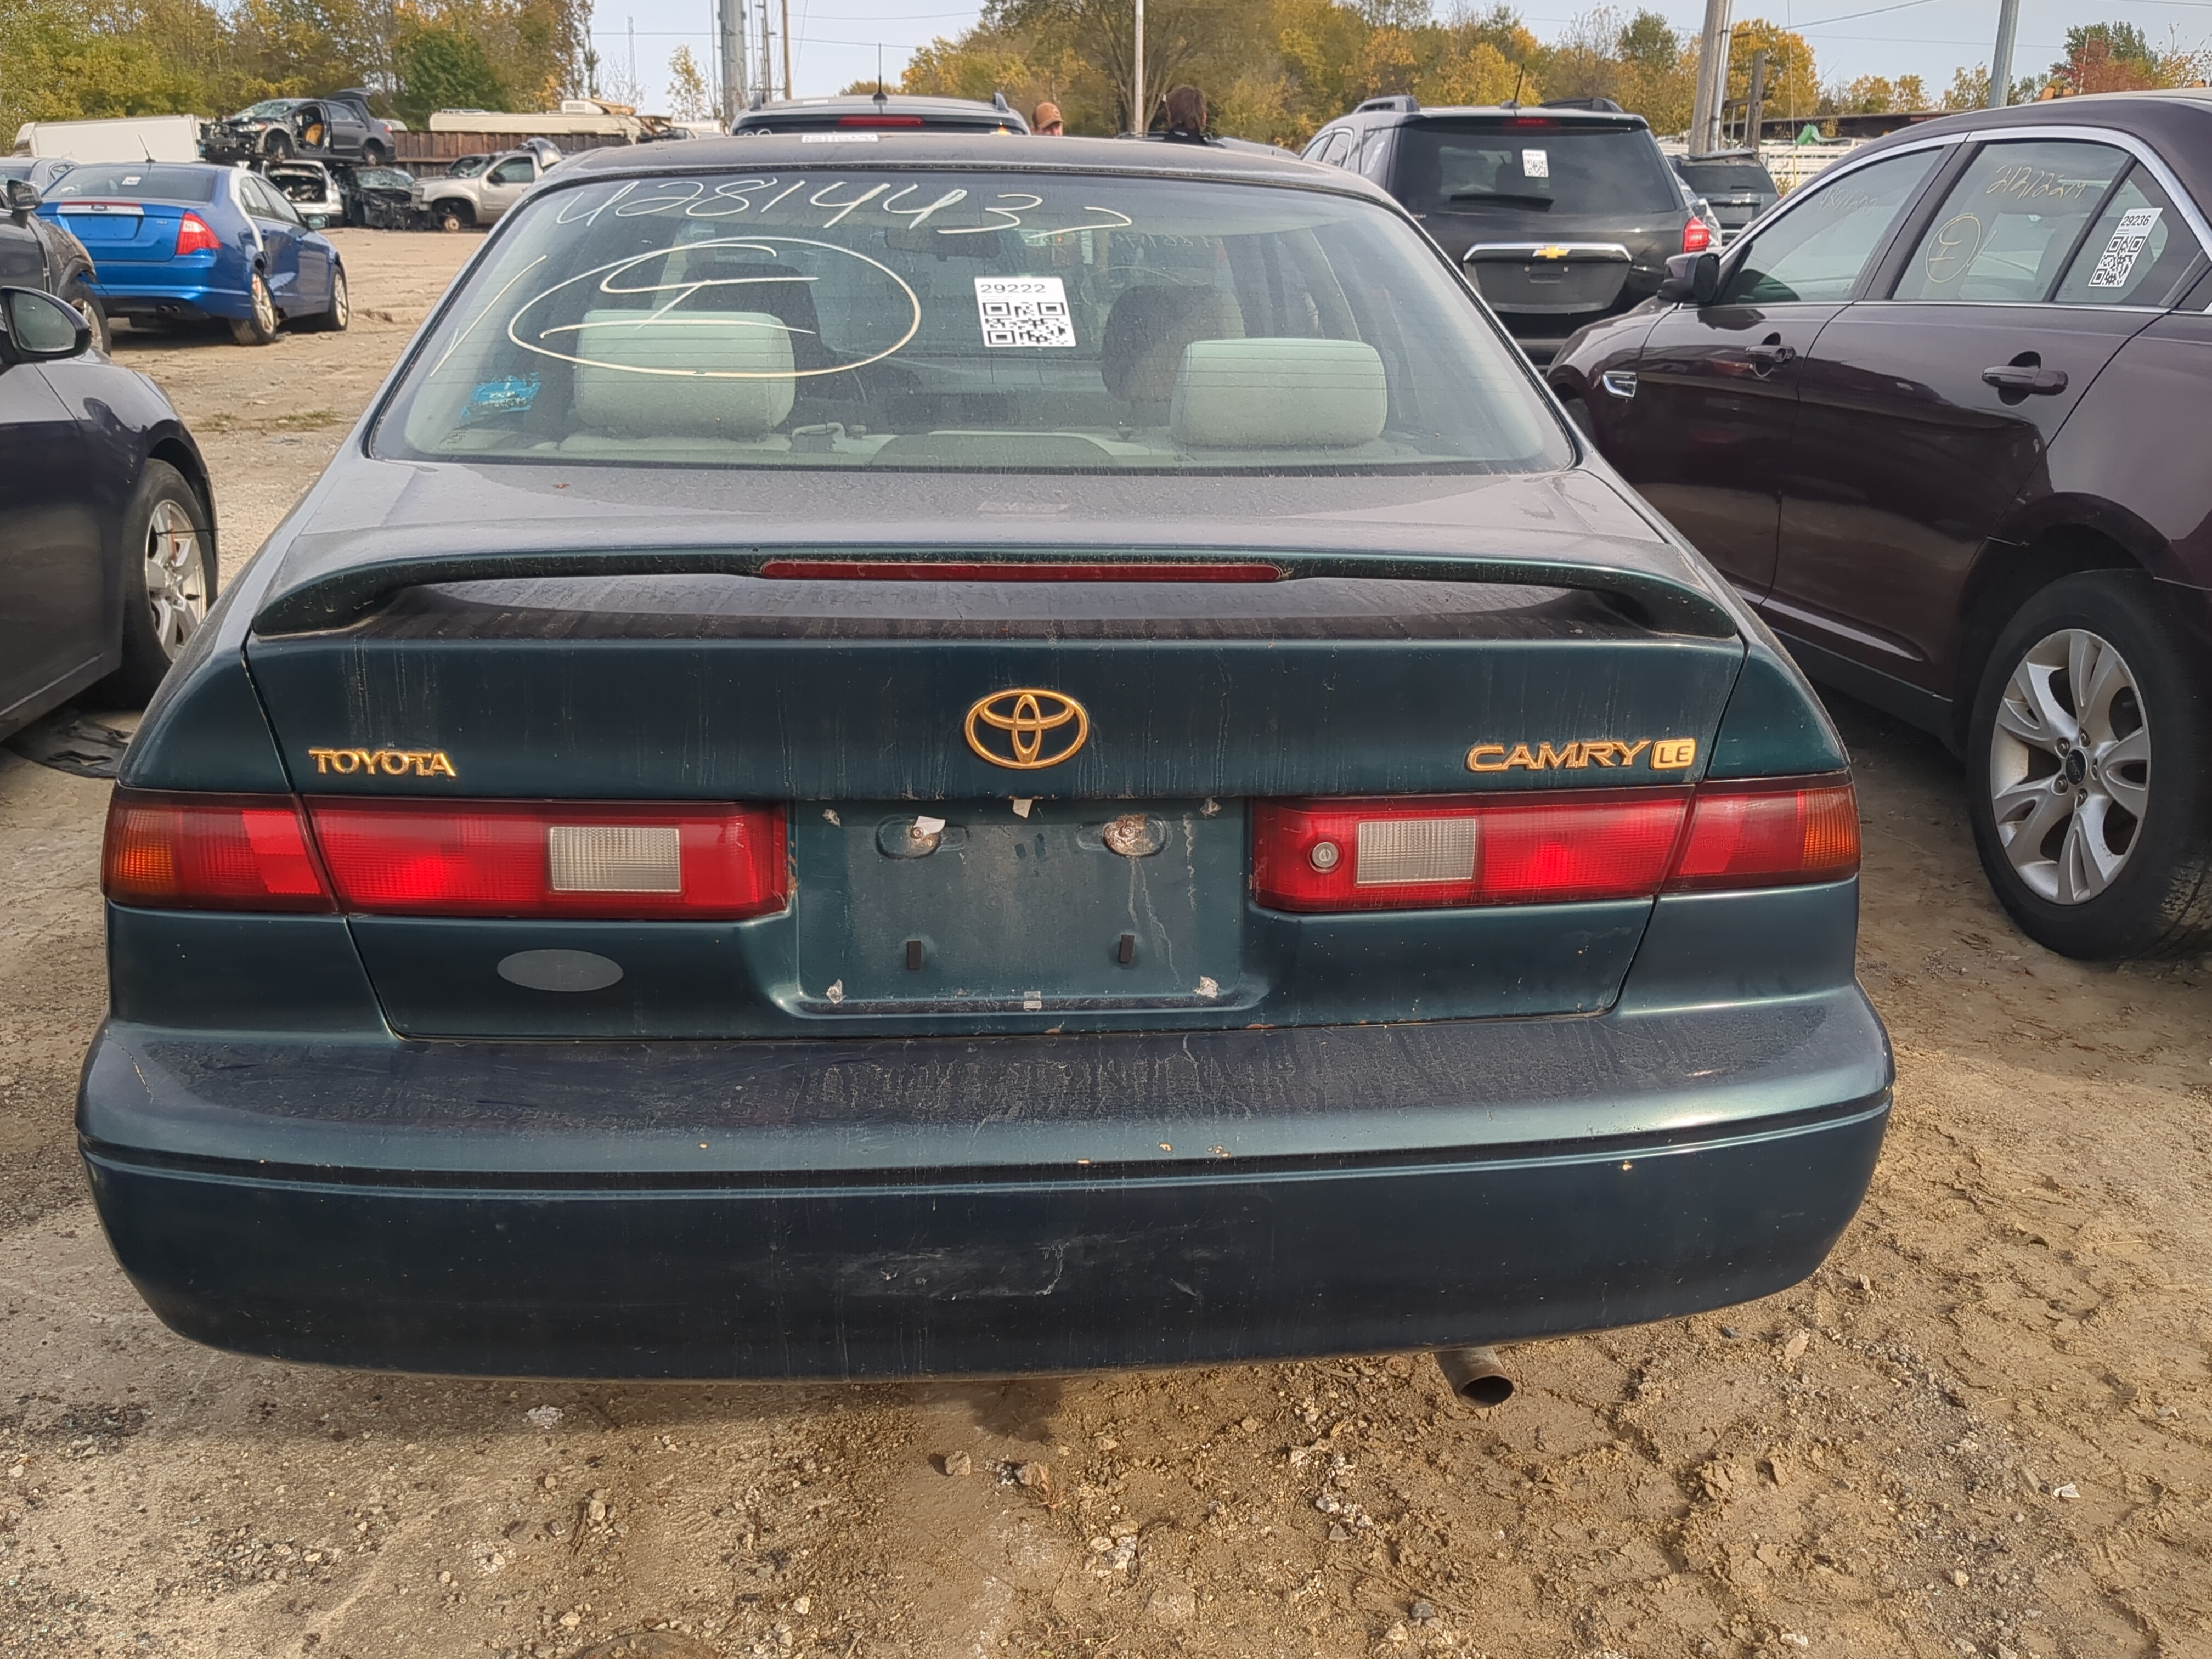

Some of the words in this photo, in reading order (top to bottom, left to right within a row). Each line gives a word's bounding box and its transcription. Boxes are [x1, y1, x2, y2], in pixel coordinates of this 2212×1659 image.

[2120, 215, 2151, 227] 29236
[980, 284, 1047, 294] 29222
[308, 748, 457, 777] TOYOTA
[1466, 740, 1651, 772] CAMRY
[1658, 744, 1691, 764] LE
